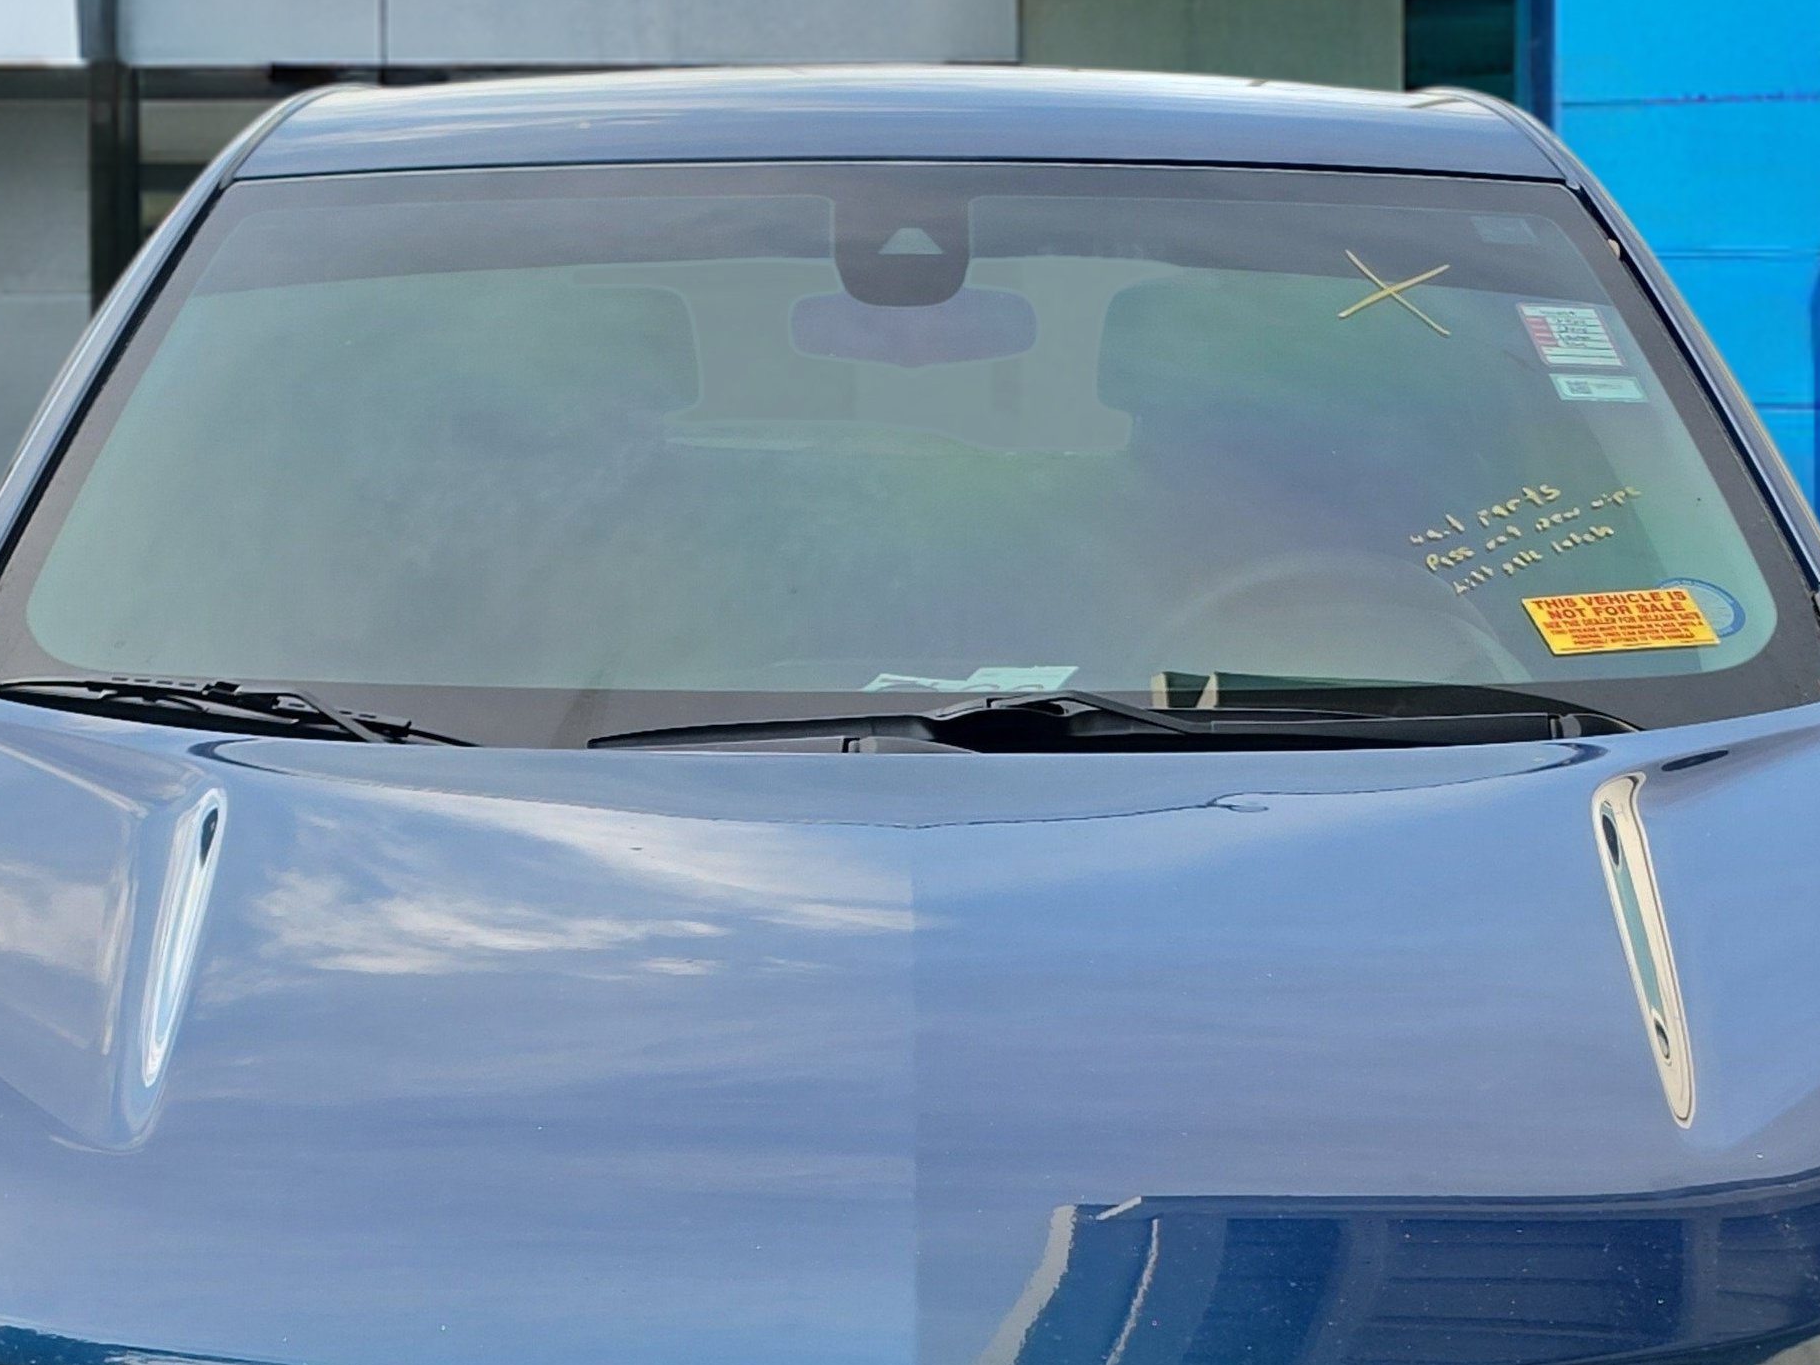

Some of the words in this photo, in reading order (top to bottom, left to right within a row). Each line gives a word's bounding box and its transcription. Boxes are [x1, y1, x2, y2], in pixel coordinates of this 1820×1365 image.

[1532, 598, 1577, 610] THIS
[1581, 592, 1663, 606] VEHICLE
[1667, 591, 1687, 601] IS
[1547, 607, 1585, 619] NOT
[1592, 604, 1633, 616] FOR
[1636, 602, 1685, 613] SALE
